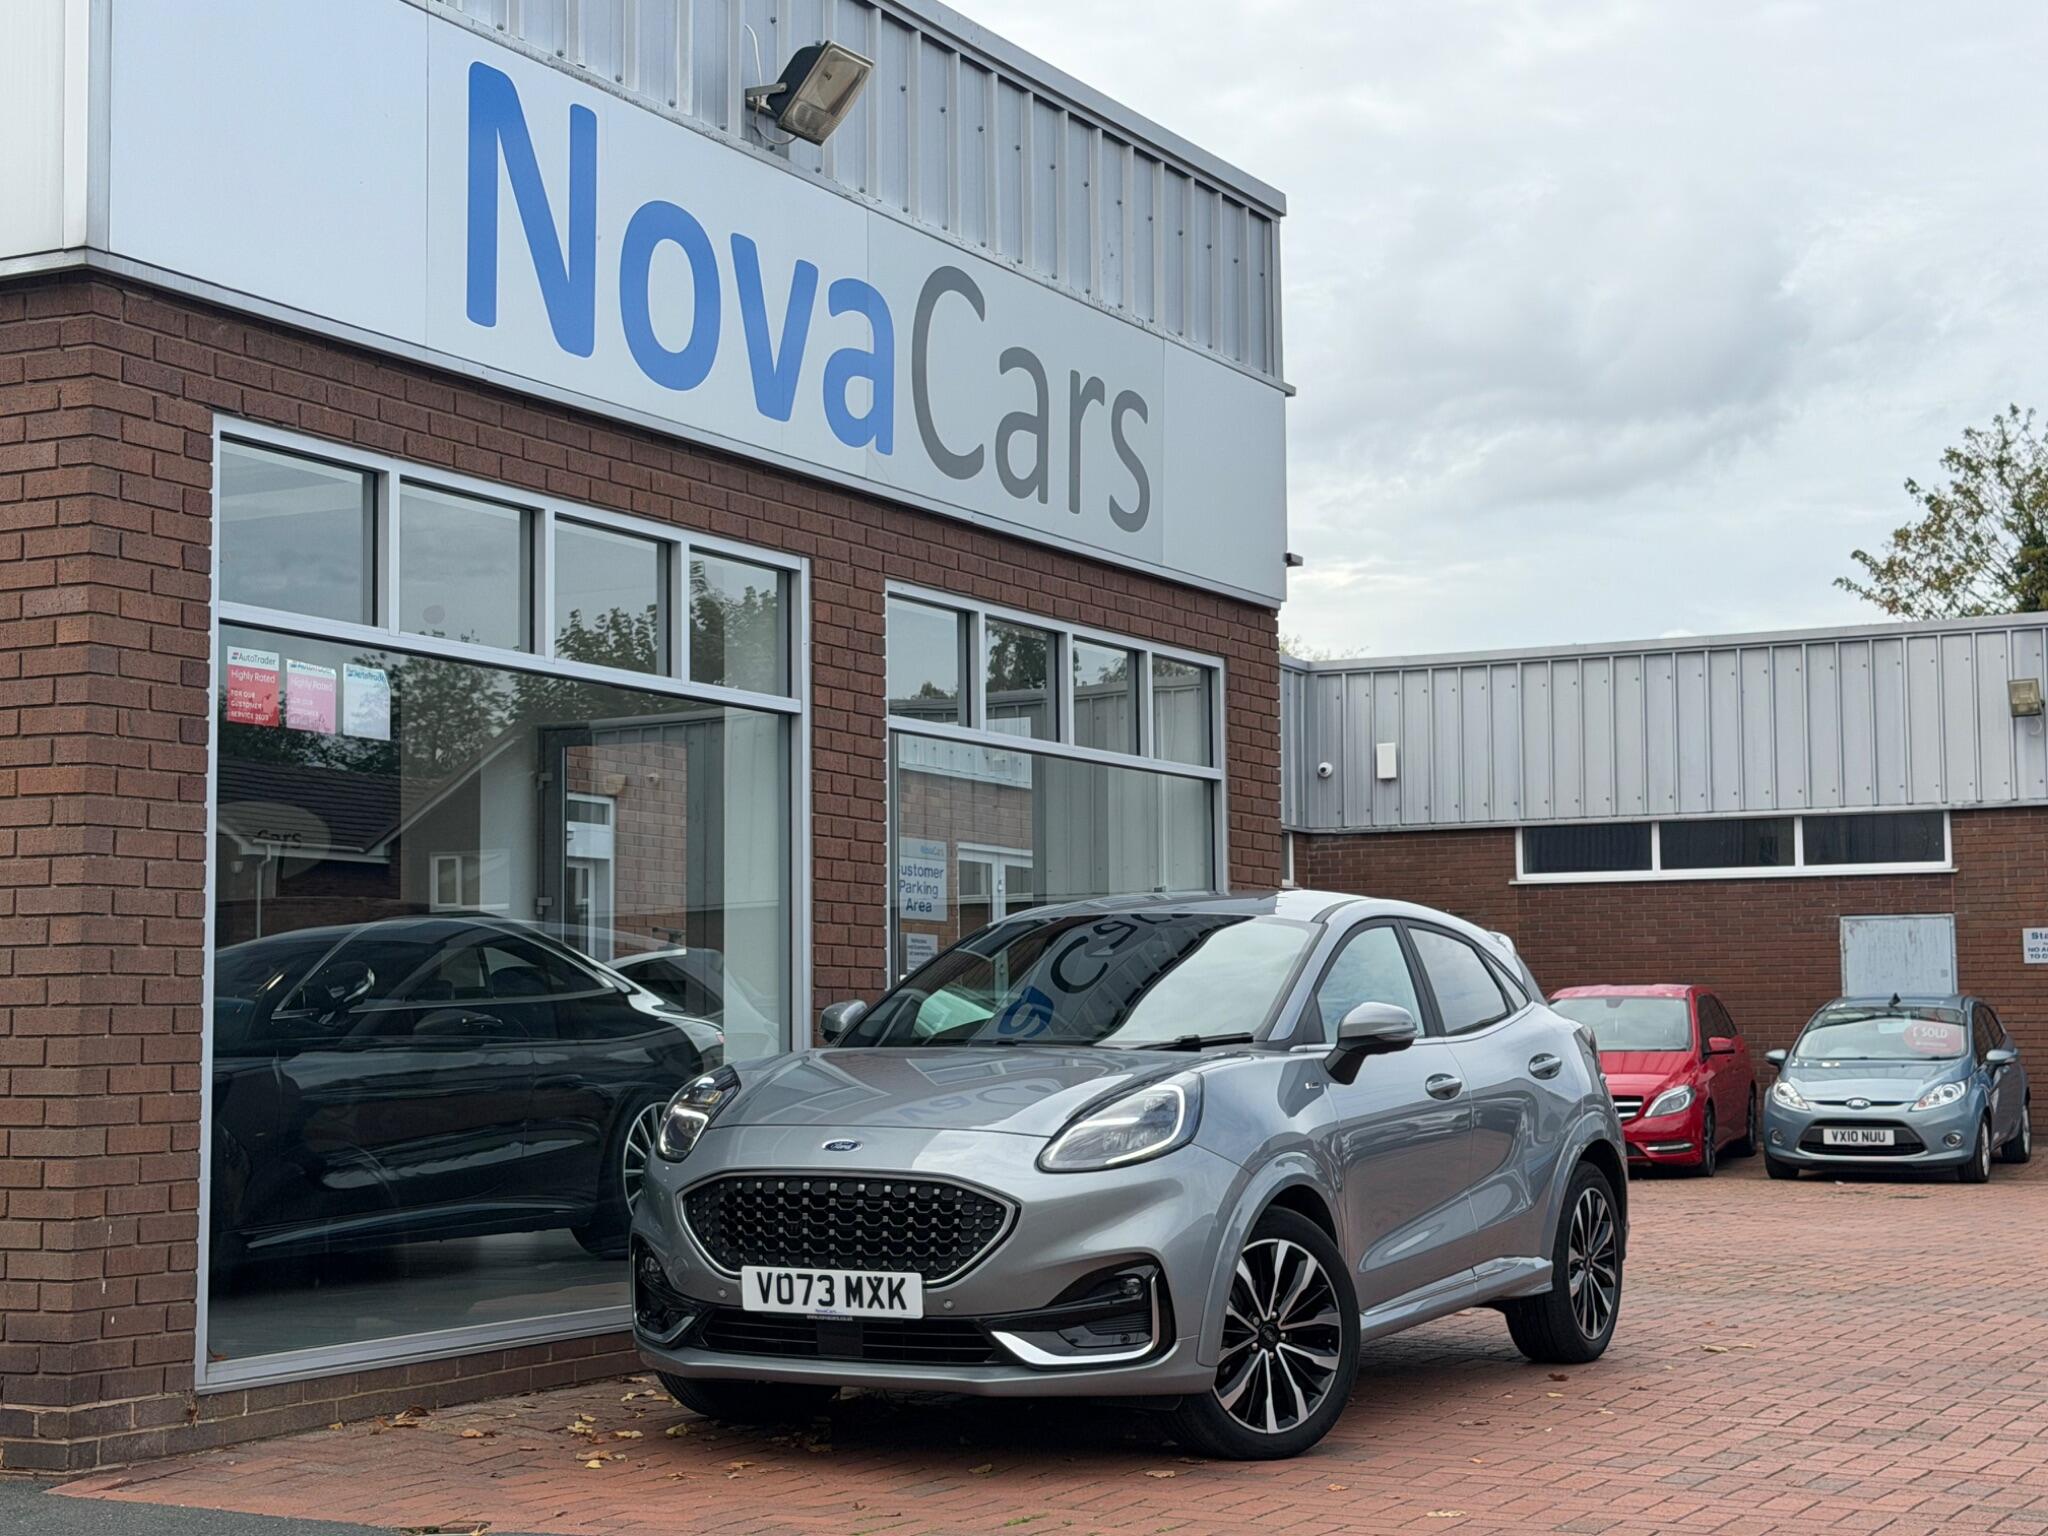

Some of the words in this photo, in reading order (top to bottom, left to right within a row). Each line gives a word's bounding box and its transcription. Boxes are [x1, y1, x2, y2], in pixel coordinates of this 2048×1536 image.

[466, 61, 1151, 533] NovaCars
[239, 652, 276, 666] AutoTrader
[231, 669, 253, 682] Highly
[254, 672, 276, 684] Rated
[899, 879, 939, 899] Parking
[905, 897, 933, 913] Area
[1831, 1130, 1858, 1143] VX10
[1861, 1130, 1886, 1143] NUU
[756, 1271, 836, 1308] VO73
[844, 1274, 908, 1311] MXK
